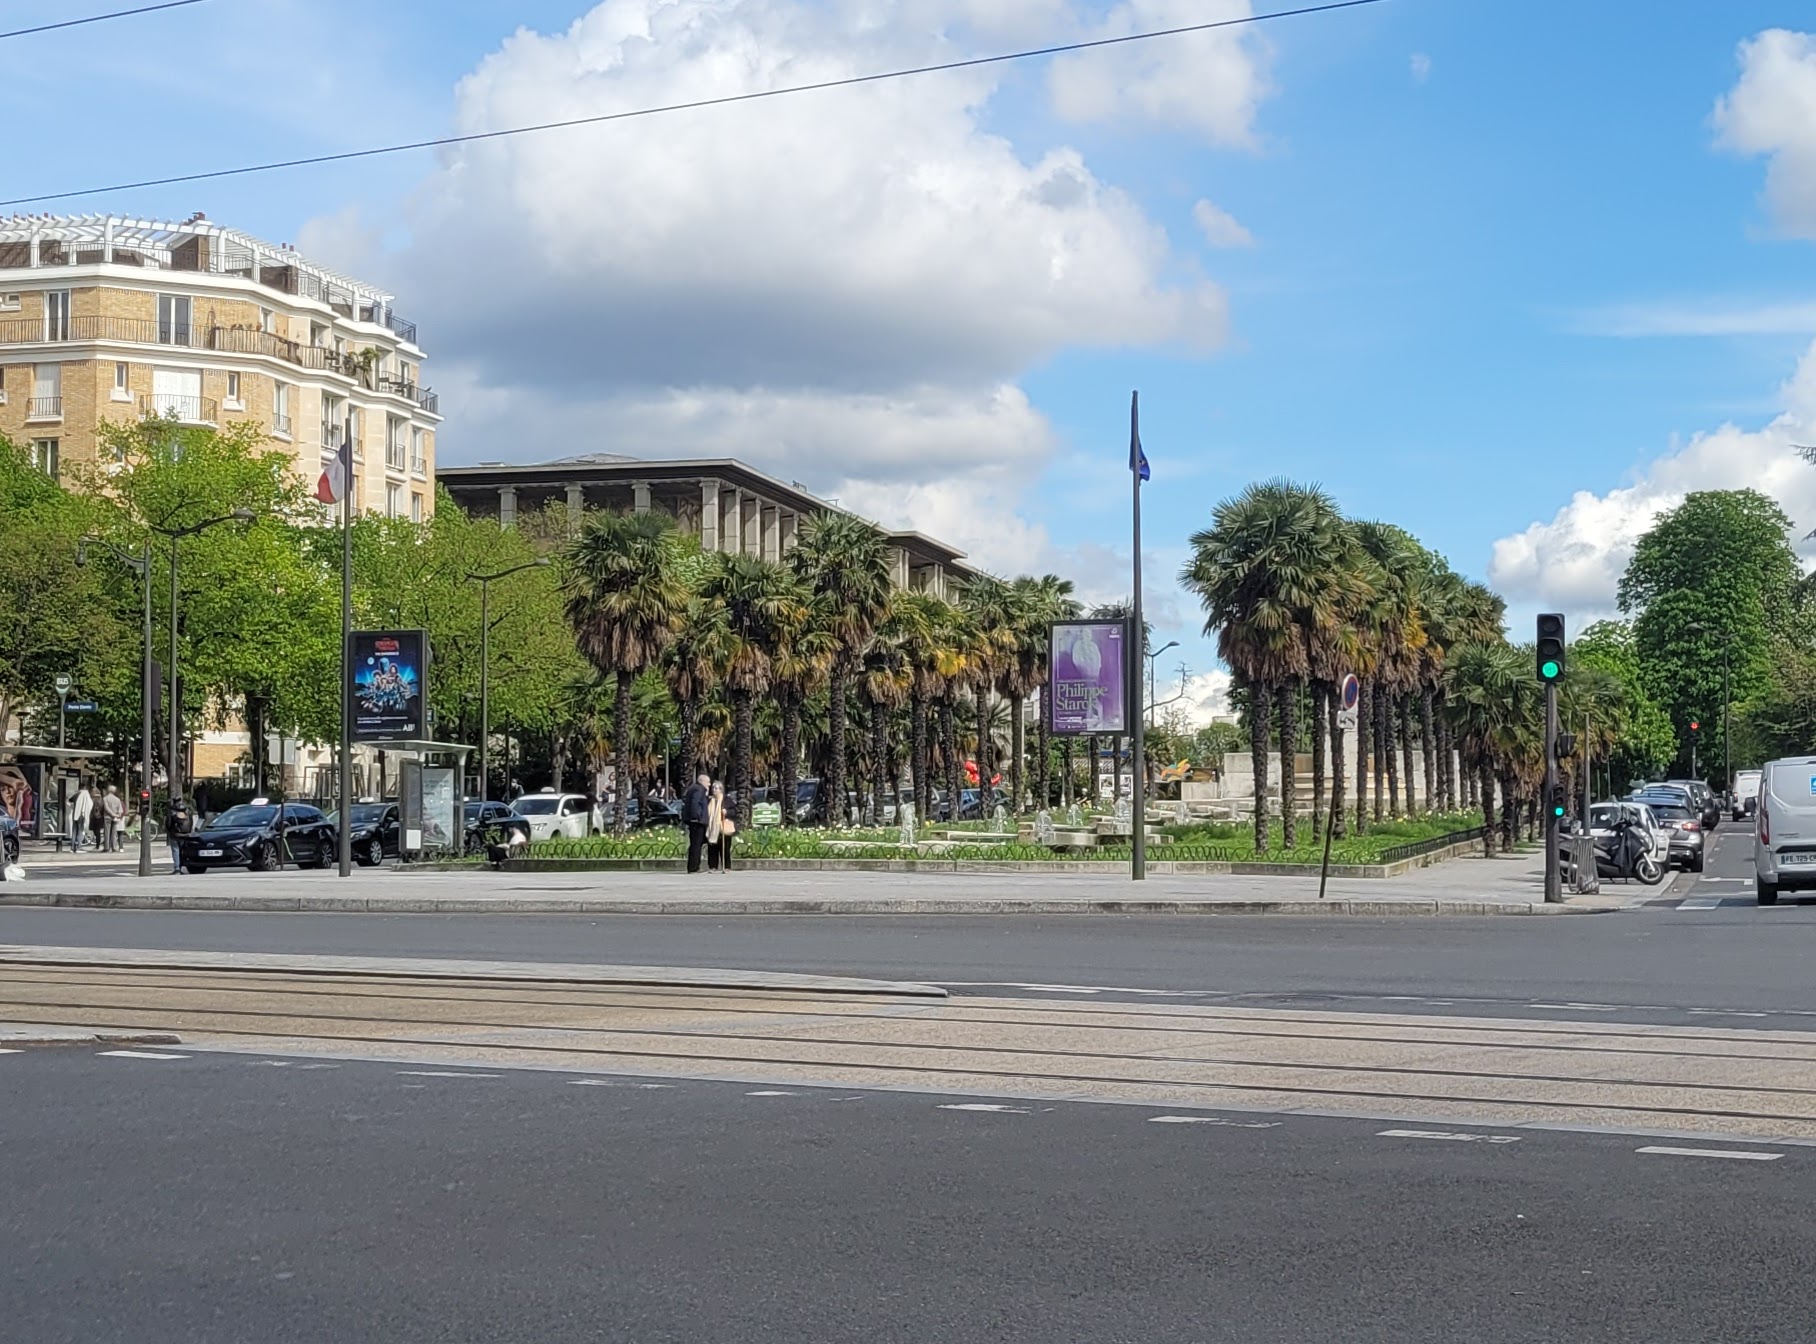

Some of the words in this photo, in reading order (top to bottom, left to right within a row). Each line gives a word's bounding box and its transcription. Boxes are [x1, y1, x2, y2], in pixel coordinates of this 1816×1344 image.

[56, 677, 69, 685] BUS
[1056, 683, 1108, 699] Philippe
[1056, 697, 1098, 711] Starck
